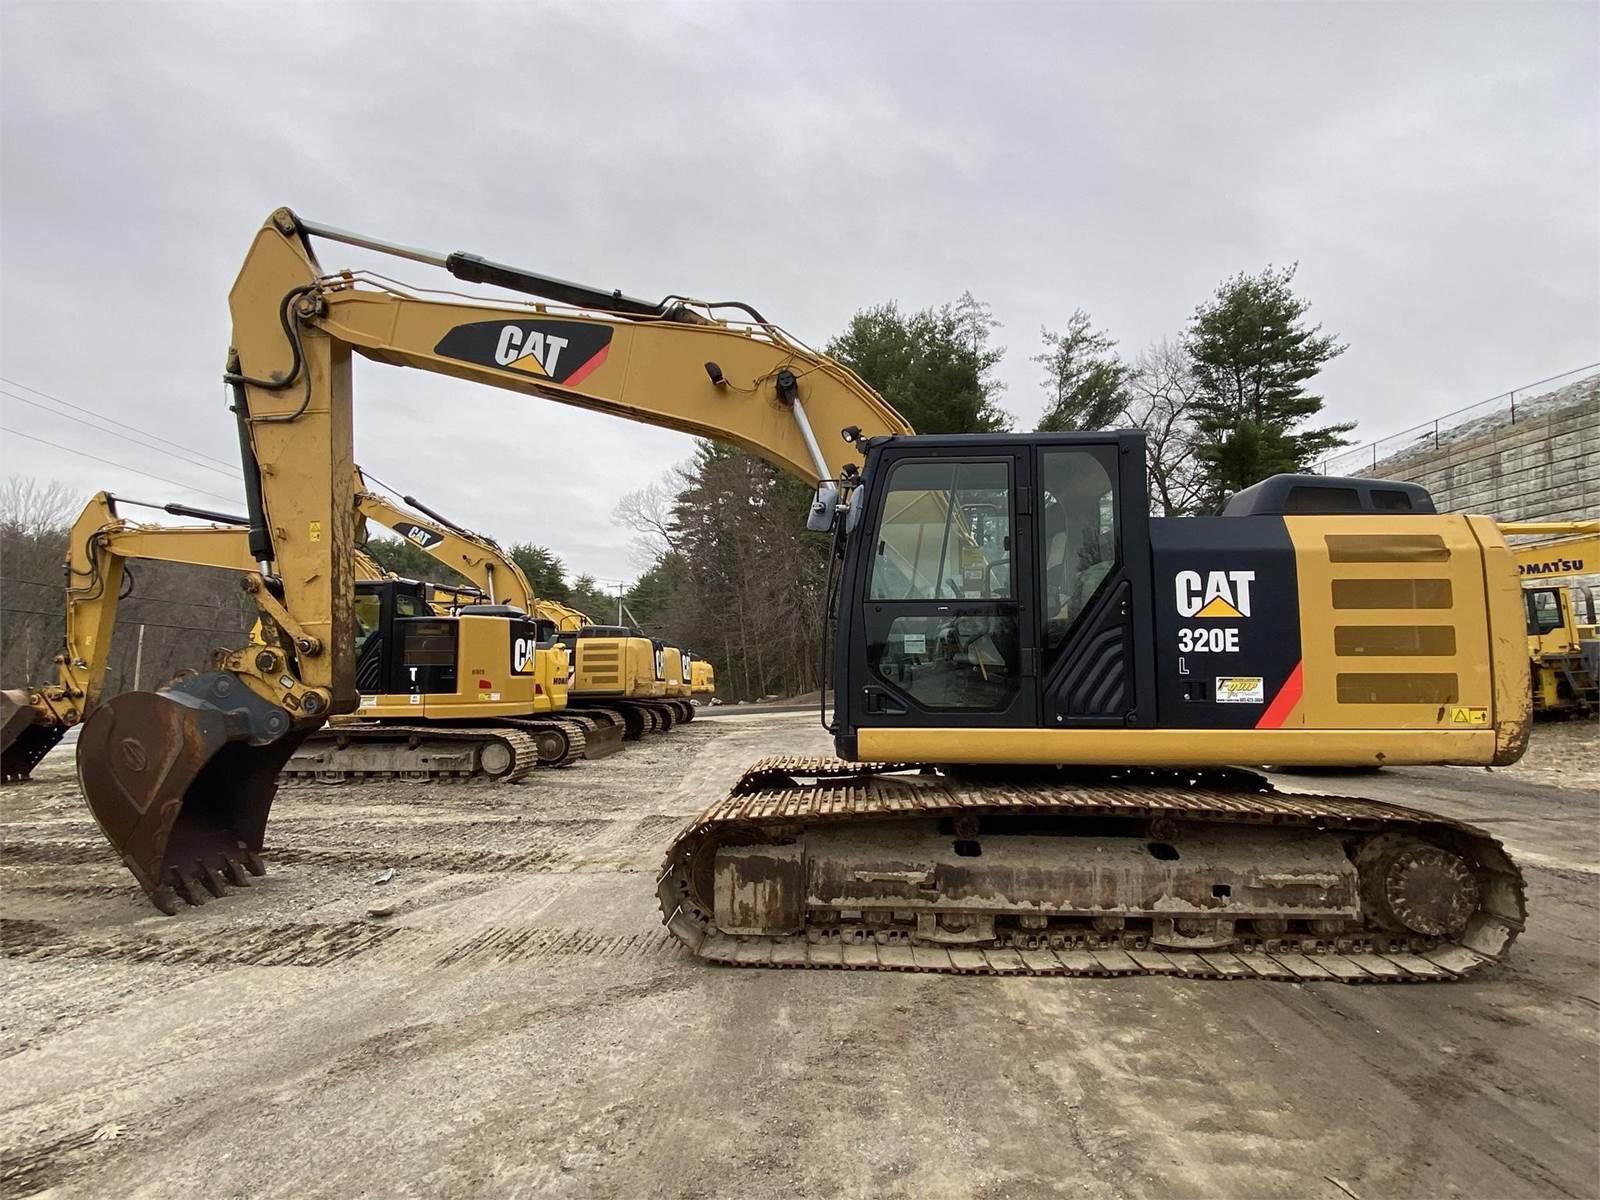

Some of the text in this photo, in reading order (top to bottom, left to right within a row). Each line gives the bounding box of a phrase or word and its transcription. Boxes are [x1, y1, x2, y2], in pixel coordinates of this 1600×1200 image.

[495, 325, 568, 377] CAT
[408, 526, 432, 546] CAT
[1518, 558, 1584, 575] OMATSU
[1175, 570, 1255, 618] CAT
[1178, 628, 1240, 653] 320E
[1179, 657, 1190, 674] L
